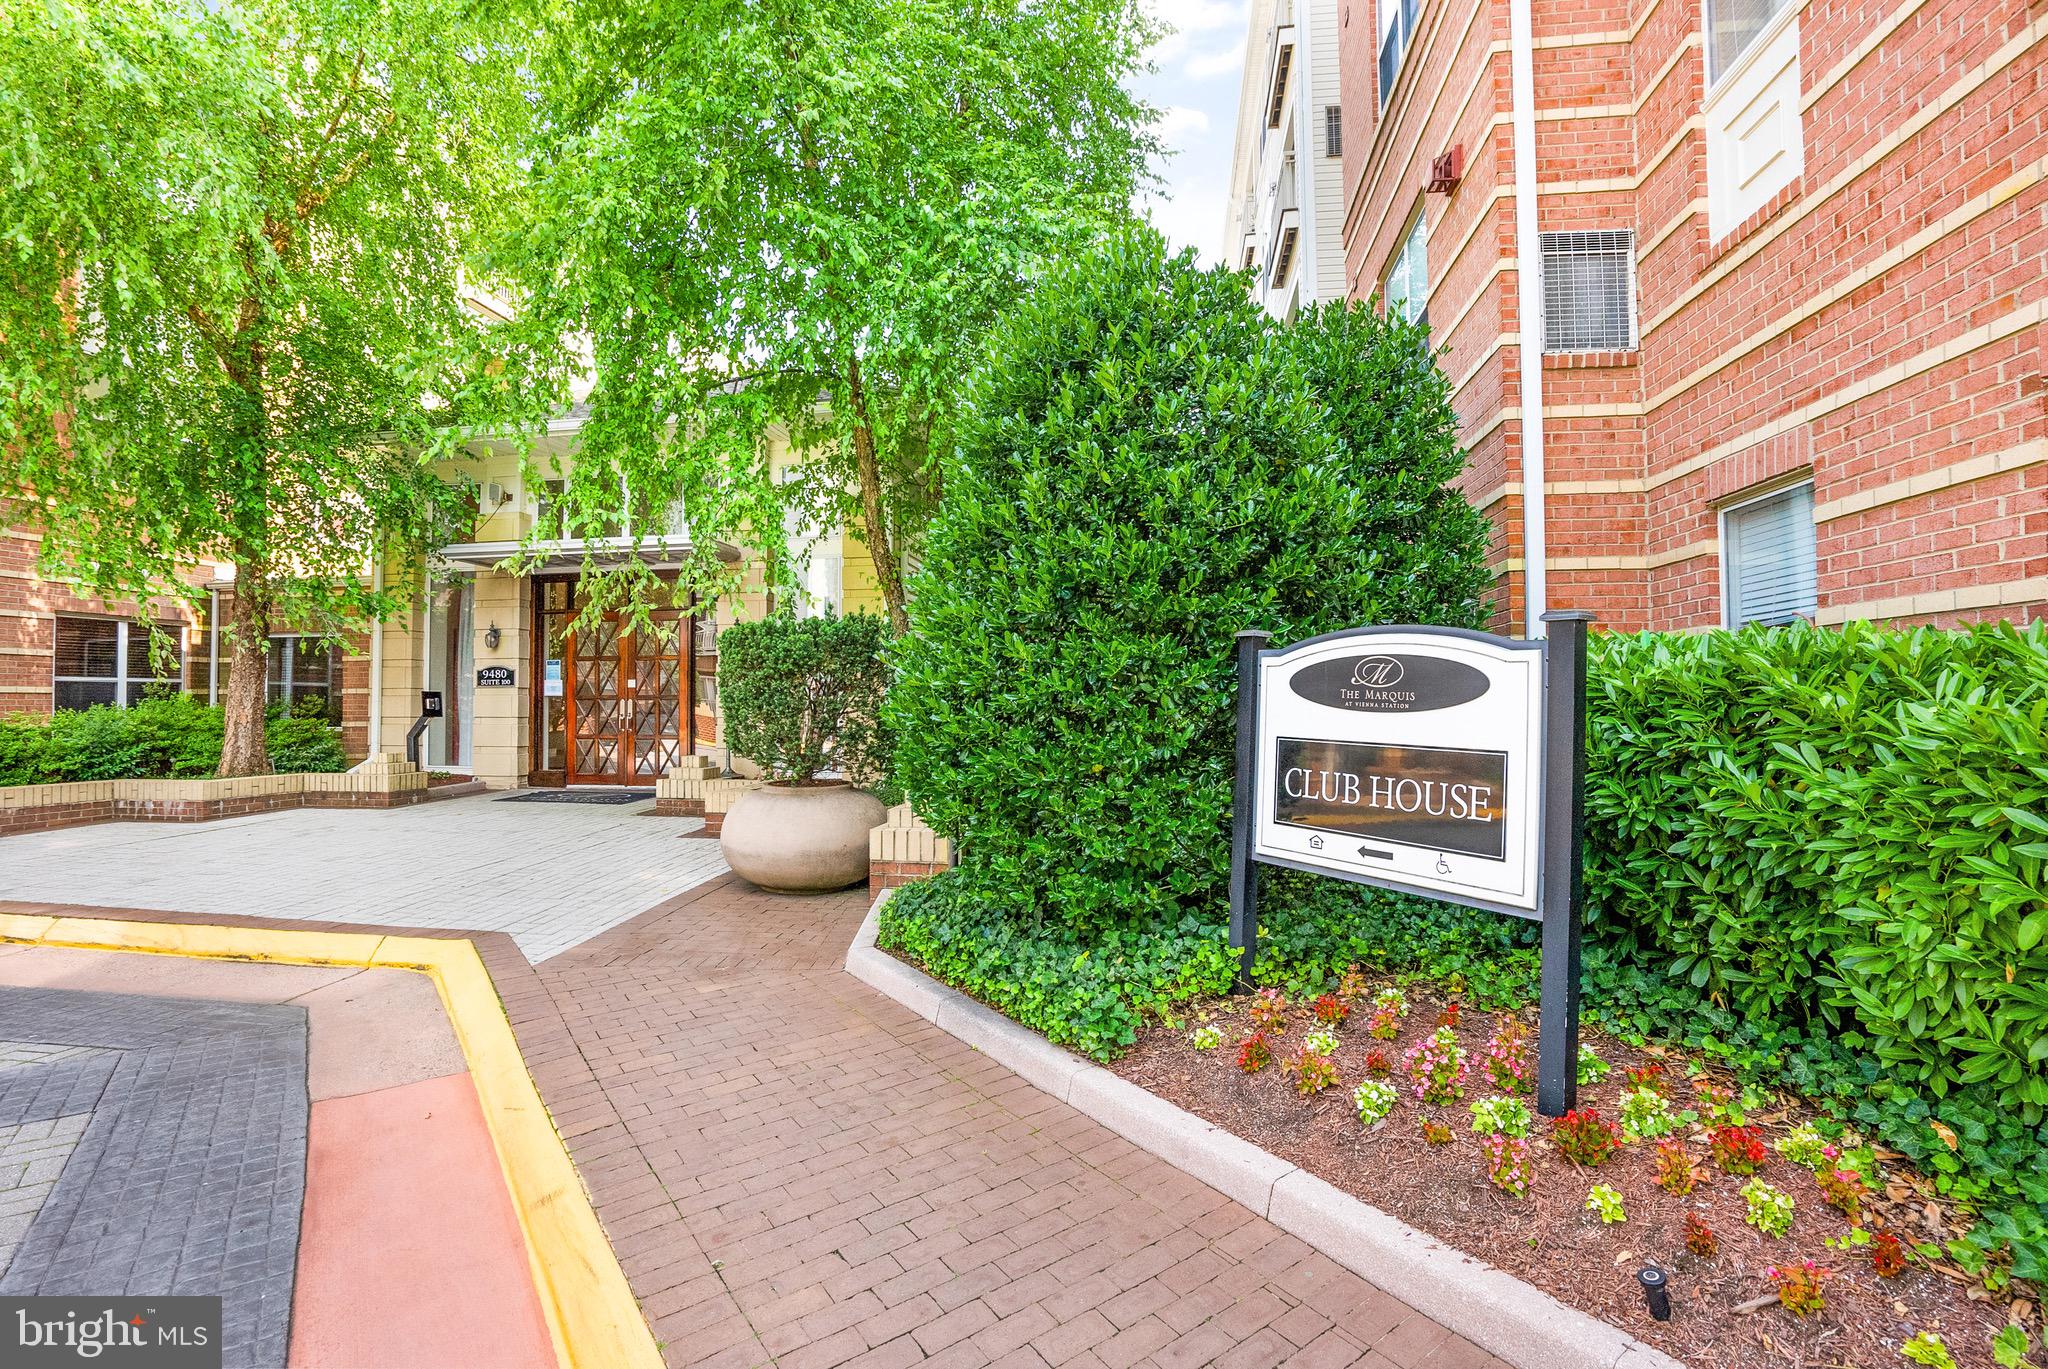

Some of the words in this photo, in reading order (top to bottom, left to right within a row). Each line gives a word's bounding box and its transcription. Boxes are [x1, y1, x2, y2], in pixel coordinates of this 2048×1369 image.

[482, 669, 507, 679] 9480
[1340, 688, 1360, 699] THE
[1365, 689, 1416, 703] MARQUIS
[1284, 767, 1361, 805] CLUB
[1368, 775, 1493, 822] HOUSE
